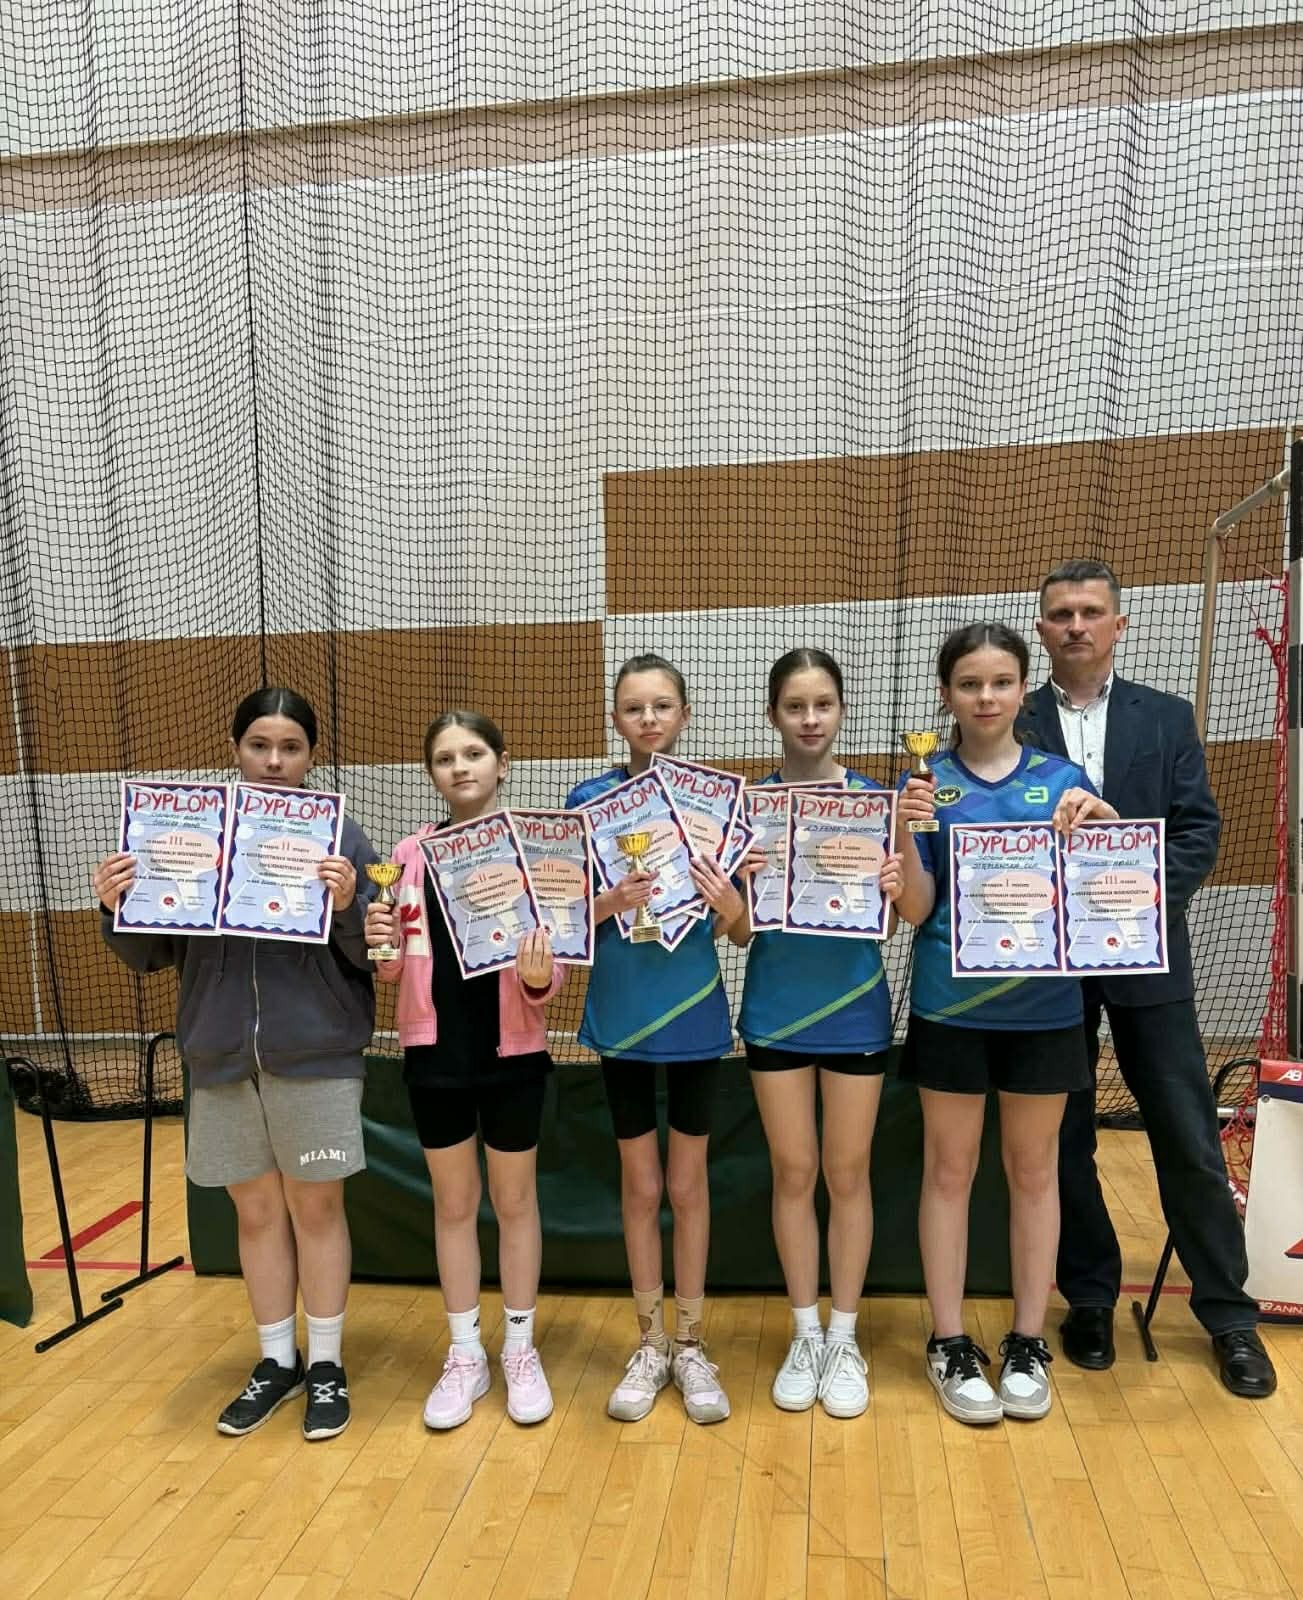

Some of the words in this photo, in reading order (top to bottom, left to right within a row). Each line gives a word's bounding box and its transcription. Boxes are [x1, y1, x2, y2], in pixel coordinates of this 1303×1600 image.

[134, 791, 219, 813] DYPLOM
[243, 795, 331, 820] DYPLOM
[588, 781, 659, 832] DYPLOM
[799, 799, 884, 819] DYPLOM
[431, 823, 506, 864] DYPLOM
[961, 834, 1049, 856] DYPLOM
[1067, 831, 1151, 854] DYPLOM
[300, 1149, 346, 1166] MIAMI
[509, 1316, 528, 1324] 4F
